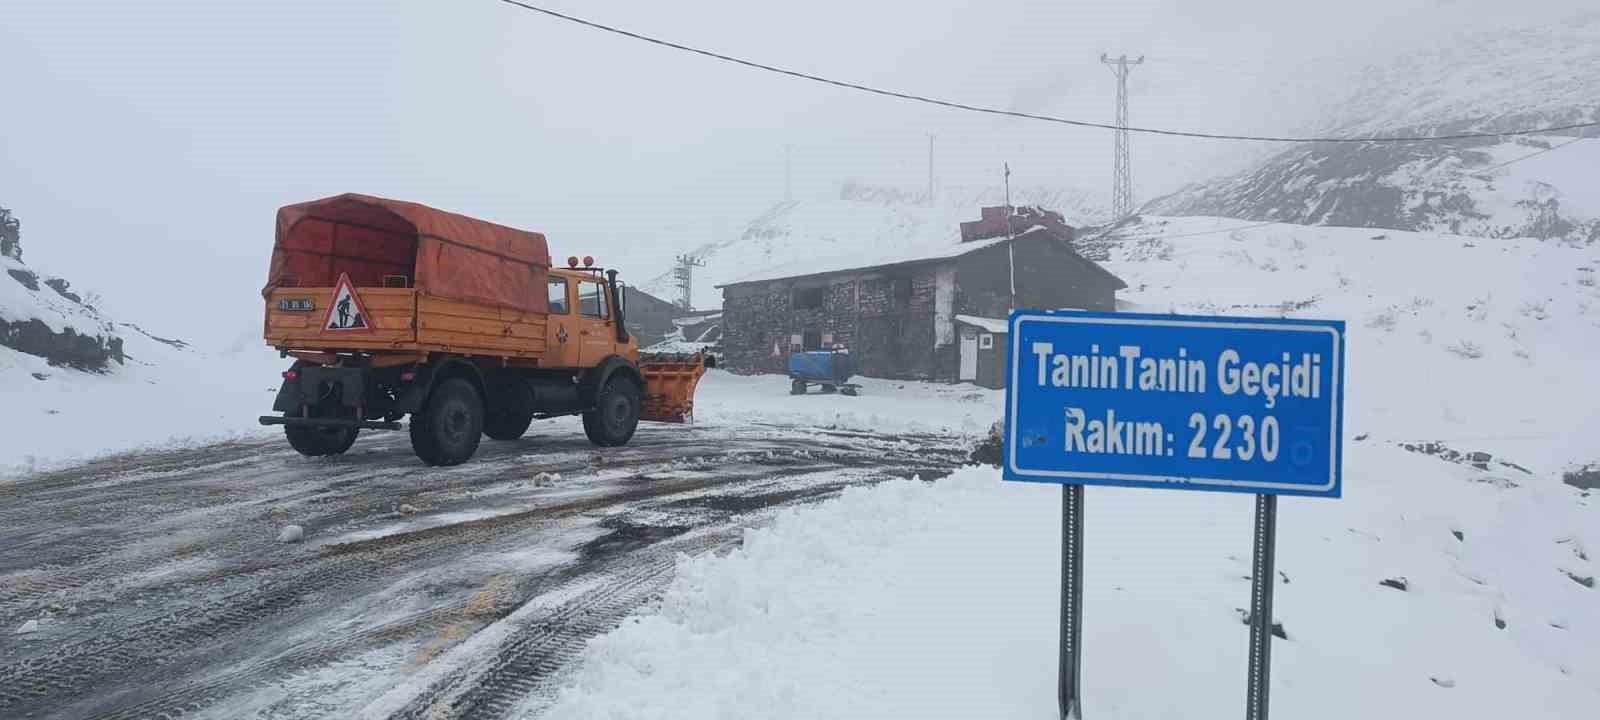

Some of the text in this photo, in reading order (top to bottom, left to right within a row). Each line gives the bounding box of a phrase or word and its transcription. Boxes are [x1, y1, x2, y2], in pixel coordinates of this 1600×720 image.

[1032, 342, 1321, 408] TaninTanin Geçidi
[1064, 406, 1280, 462] Rakım: 2230
